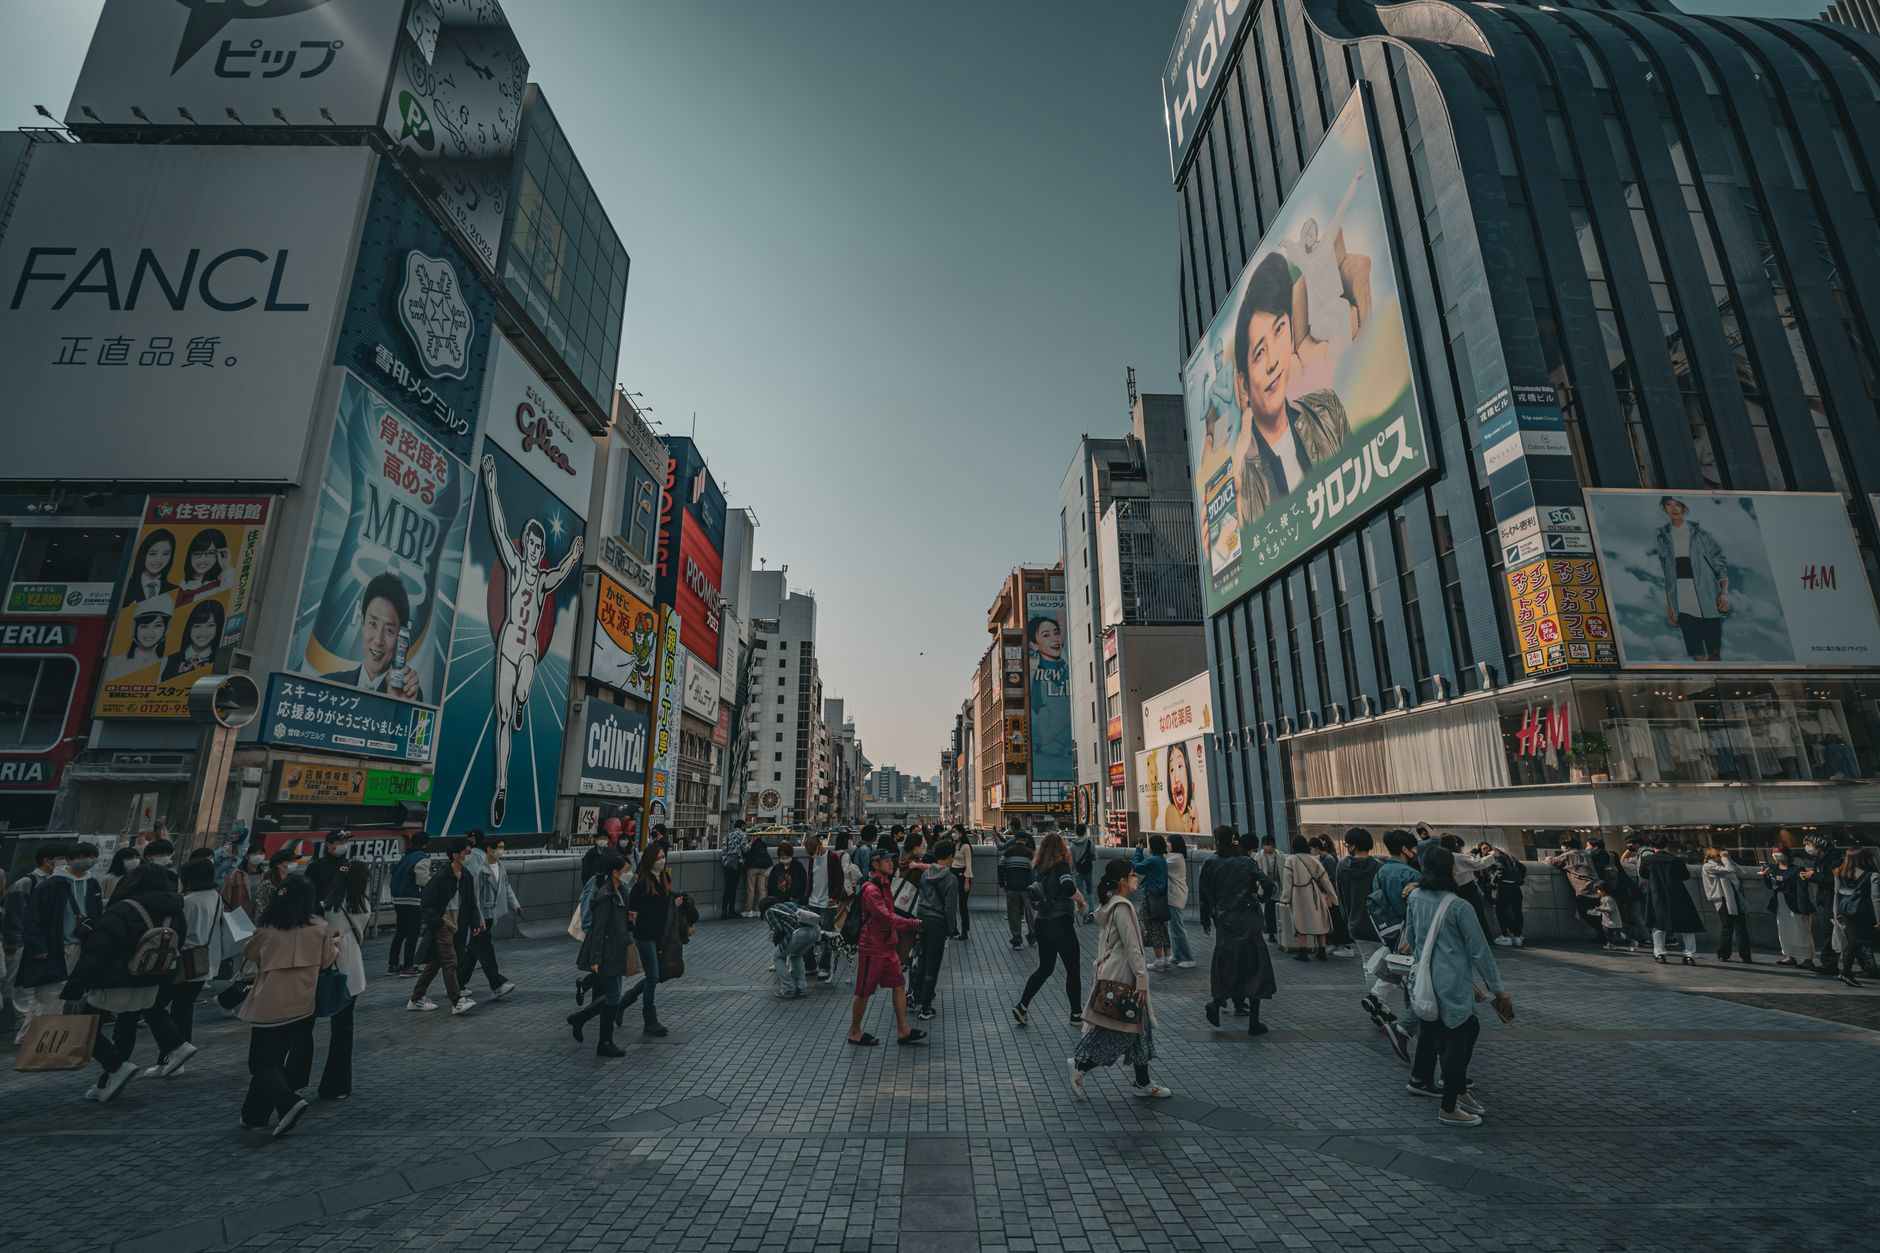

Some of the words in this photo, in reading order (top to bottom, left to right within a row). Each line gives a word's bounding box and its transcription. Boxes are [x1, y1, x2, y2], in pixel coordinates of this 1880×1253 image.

[214, 40, 344, 79] ピップ
[10, 247, 310, 312] FANCL
[52, 336, 238, 368] 正直品質。
[375, 344, 470, 436] 雪印メグミルク
[1516, 393, 1554, 402] 戎橋ビル
[1480, 398, 1509, 423] 戎橋ビル
[380, 414, 449, 484] 骨密度を
[516, 402, 577, 476] Glico
[383, 450, 436, 505] 高める
[1306, 415, 1415, 530] サロンパス
[176, 503, 262, 520] 住宅情報館
[1208, 482, 1236, 520] サロンパス
[363, 482, 437, 568] MBP
[1801, 565, 1837, 591] H&M
[606, 585, 631, 612] かぜに
[516, 588, 534, 646] グリコ
[601, 601, 631, 636] 改源
[0, 625, 63, 644] ERIA
[1035, 667, 1064, 683] new
[282, 682, 360, 710] スキージャンプ
[276, 701, 408, 738] 応援ありがとうございました!
[288, 728, 326, 741] 雪印メグミルク
[1159, 705, 1192, 733] なの花薬局
[1515, 703, 1570, 757] H&M
[319, 839, 401, 861] LTTERIA
[35, 1030, 70, 1053] GAP
